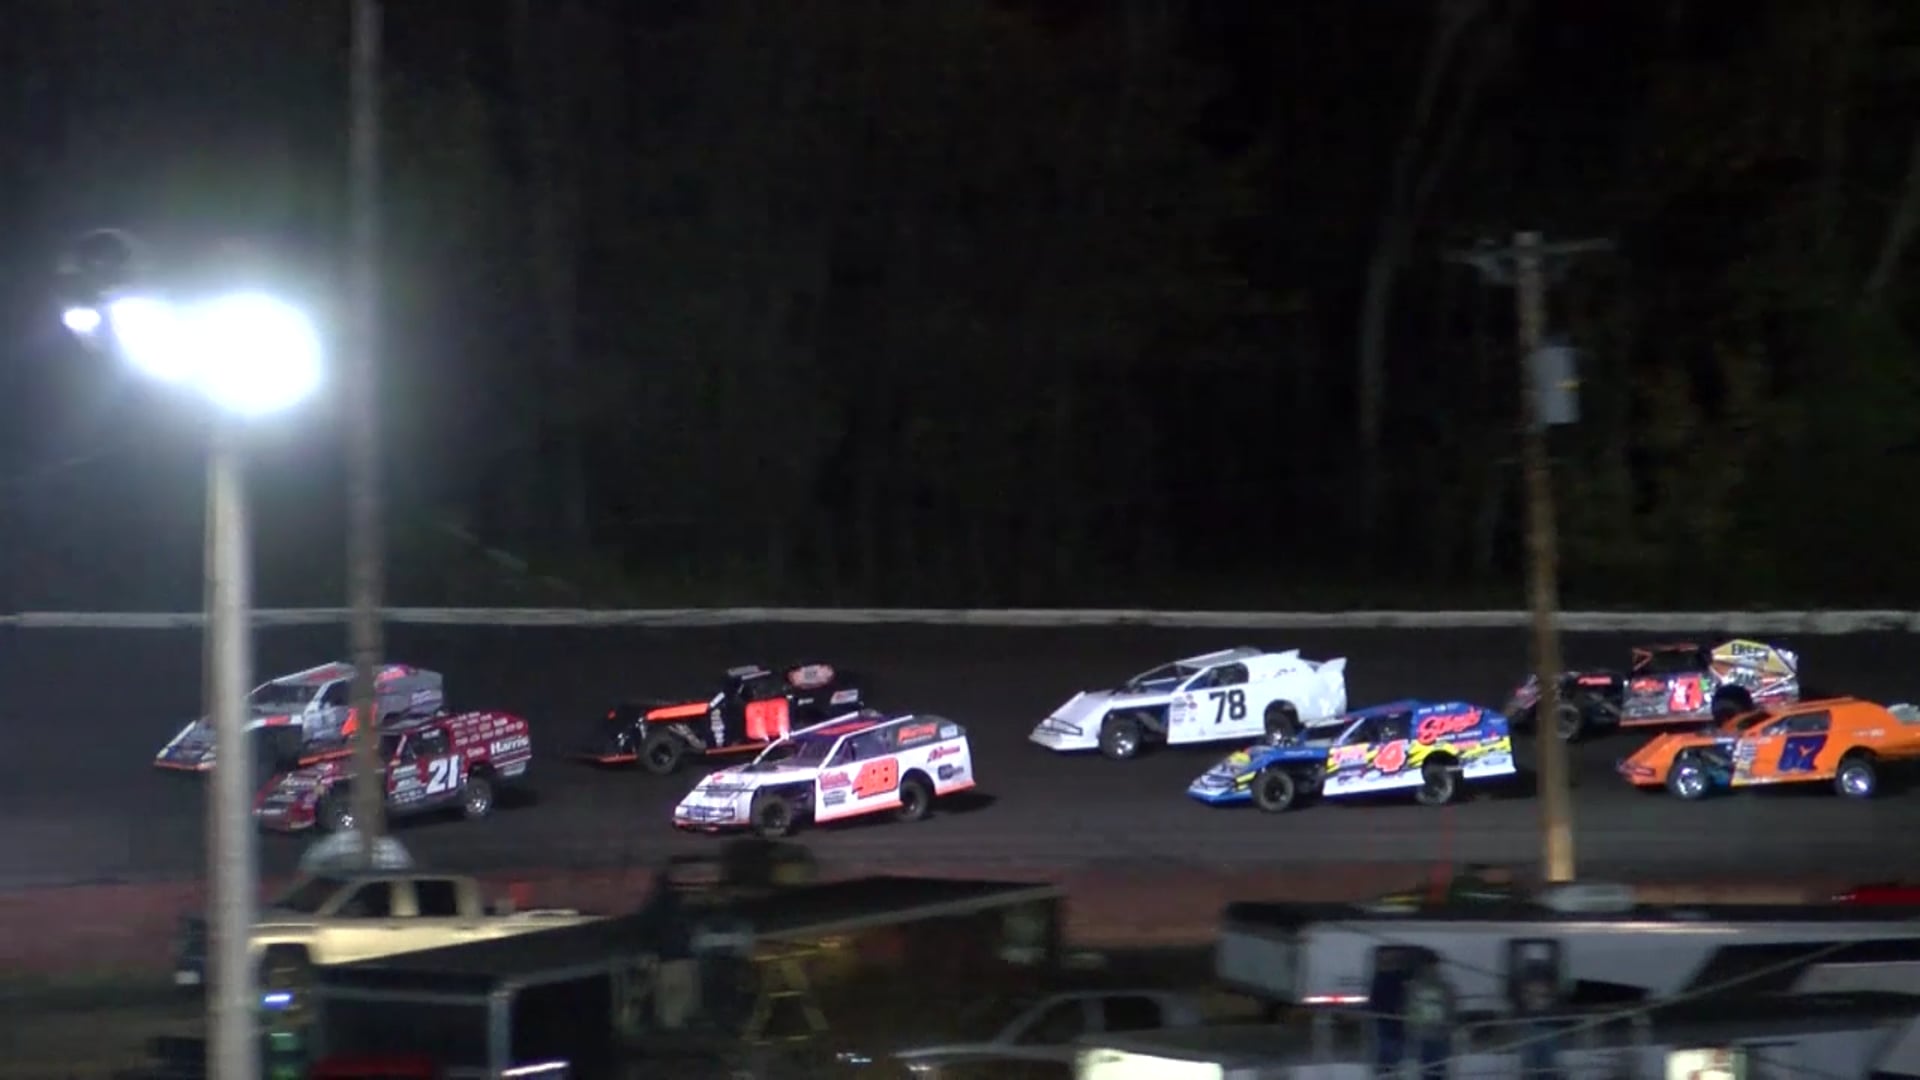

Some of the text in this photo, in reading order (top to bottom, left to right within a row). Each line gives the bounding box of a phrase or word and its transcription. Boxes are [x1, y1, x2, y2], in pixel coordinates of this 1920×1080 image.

[1209, 689, 1247, 724] 78
[1374, 734, 1405, 772] 4
[426, 755, 459, 794] 21
